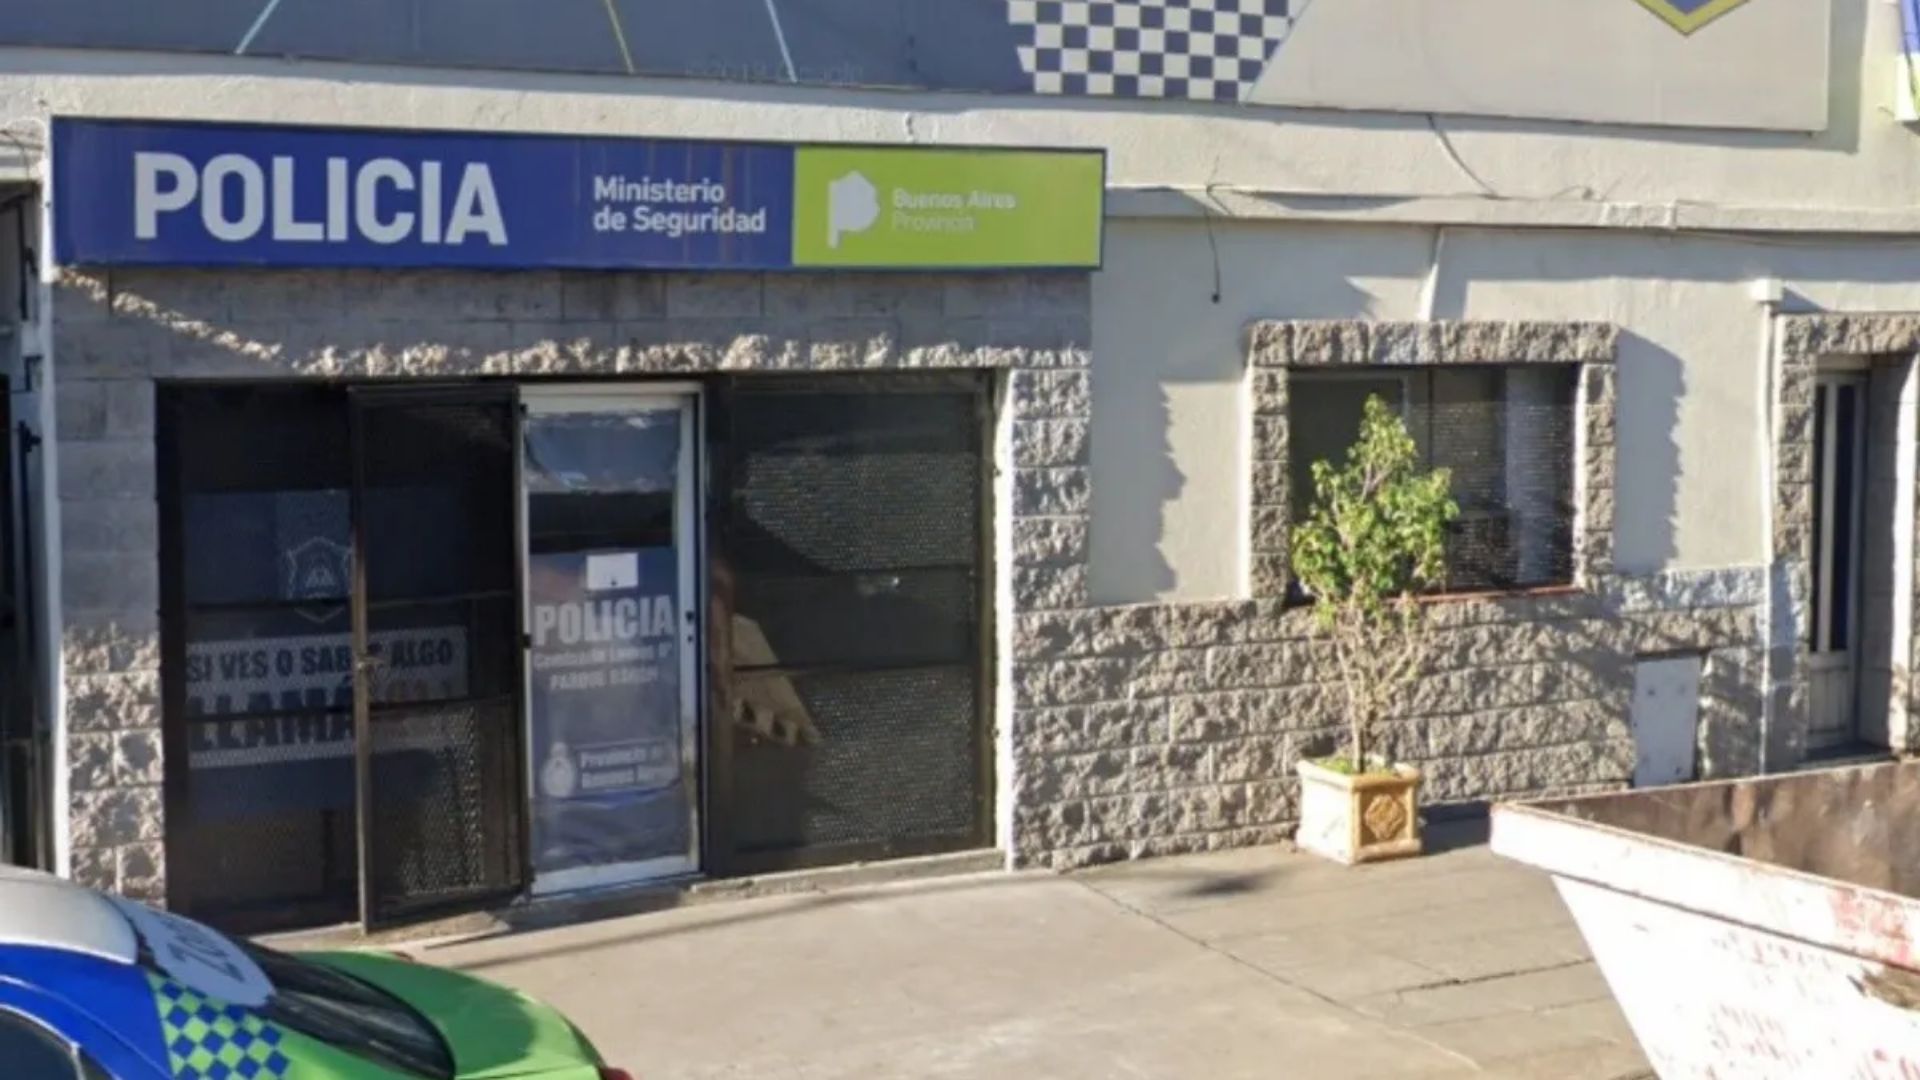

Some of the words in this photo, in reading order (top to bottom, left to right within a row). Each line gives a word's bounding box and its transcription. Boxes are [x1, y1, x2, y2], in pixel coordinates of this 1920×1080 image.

[135, 152, 508, 246] POLICIA
[593, 174, 726, 203] Ministerio
[891, 186, 962, 210] Buenos
[966, 188, 1017, 210] Aires
[593, 204, 627, 232] de
[633, 204, 767, 238] Seguridad
[534, 595, 676, 647] POLICIA
[186, 652, 213, 683] SI
[219, 649, 269, 681] VES
[276, 647, 294, 677] O
[391, 637, 453, 668] ALGO
